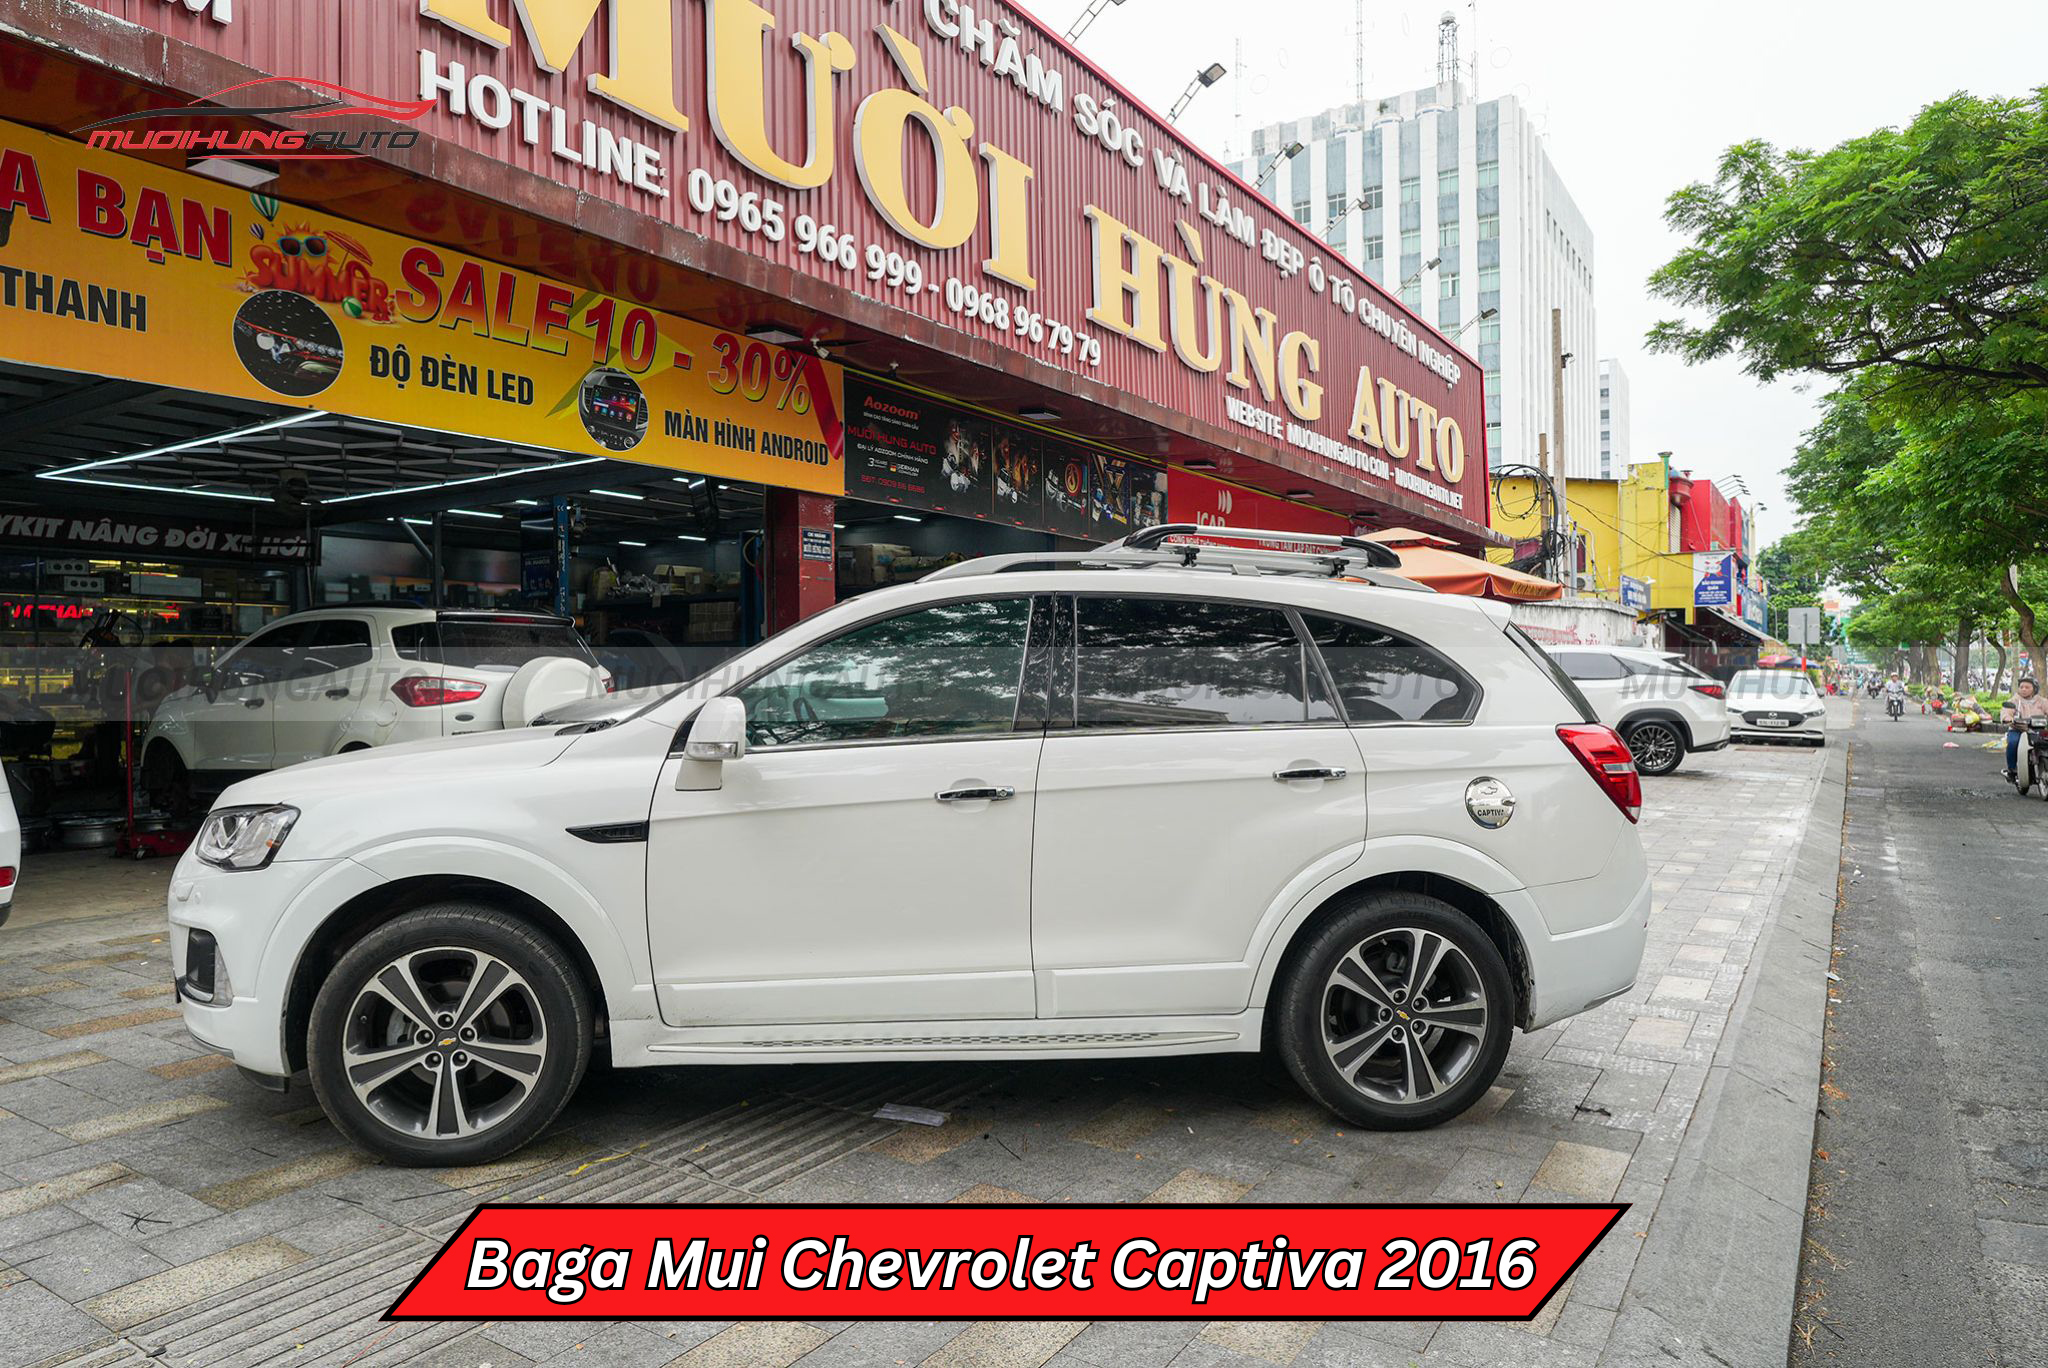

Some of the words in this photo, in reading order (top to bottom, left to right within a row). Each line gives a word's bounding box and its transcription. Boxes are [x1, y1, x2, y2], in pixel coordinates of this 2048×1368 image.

[77, 168, 232, 268] BẠN
[420, 48, 669, 198] HOTLINE:
[688, 168, 785, 242] 0965
[795, 214, 857, 271] 966
[866, 244, 922, 295] 999
[946, 277, 1010, 330] 0968
[1013, 305, 1043, 343] 96
[1044, 318, 1073, 355] 79
[1075, 332, 1101, 366] 79
[1073, 92, 1144, 168] SÓC
[1152, 147, 1192, 205] VÀ
[1199, 182, 1255, 248] LÀM
[1261, 228, 1304, 278] ĐẸP
[1308, 256, 1325, 293] Ô
[1328, 275, 1355, 314] TÔ
[1358, 297, 1417, 358] CHUYÊN
[1418, 339, 1461, 389] NGHIỆP
[0, 264, 147, 333] THANH
[249, 244, 395, 324] SUMMER
[395, 246, 575, 357] SALE
[585, 297, 658, 374] 10
[707, 332, 813, 415] 30%
[369, 343, 411, 389] ĐỘ
[420, 353, 478, 396] ĐÈN
[487, 368, 535, 406] LED
[1084, 204, 1324, 421] HÙNG
[1348, 365, 1465, 483] AUTO
[664, 408, 708, 443] MÀN
[714, 414, 756, 453] HÌNH
[760, 431, 830, 466] ANDROID
[863, 395, 919, 420] Aozoom
[867, 457, 875, 467] 3
[68, 517, 159, 546] NÂNG
[164, 525, 218, 550] ĐỜI
